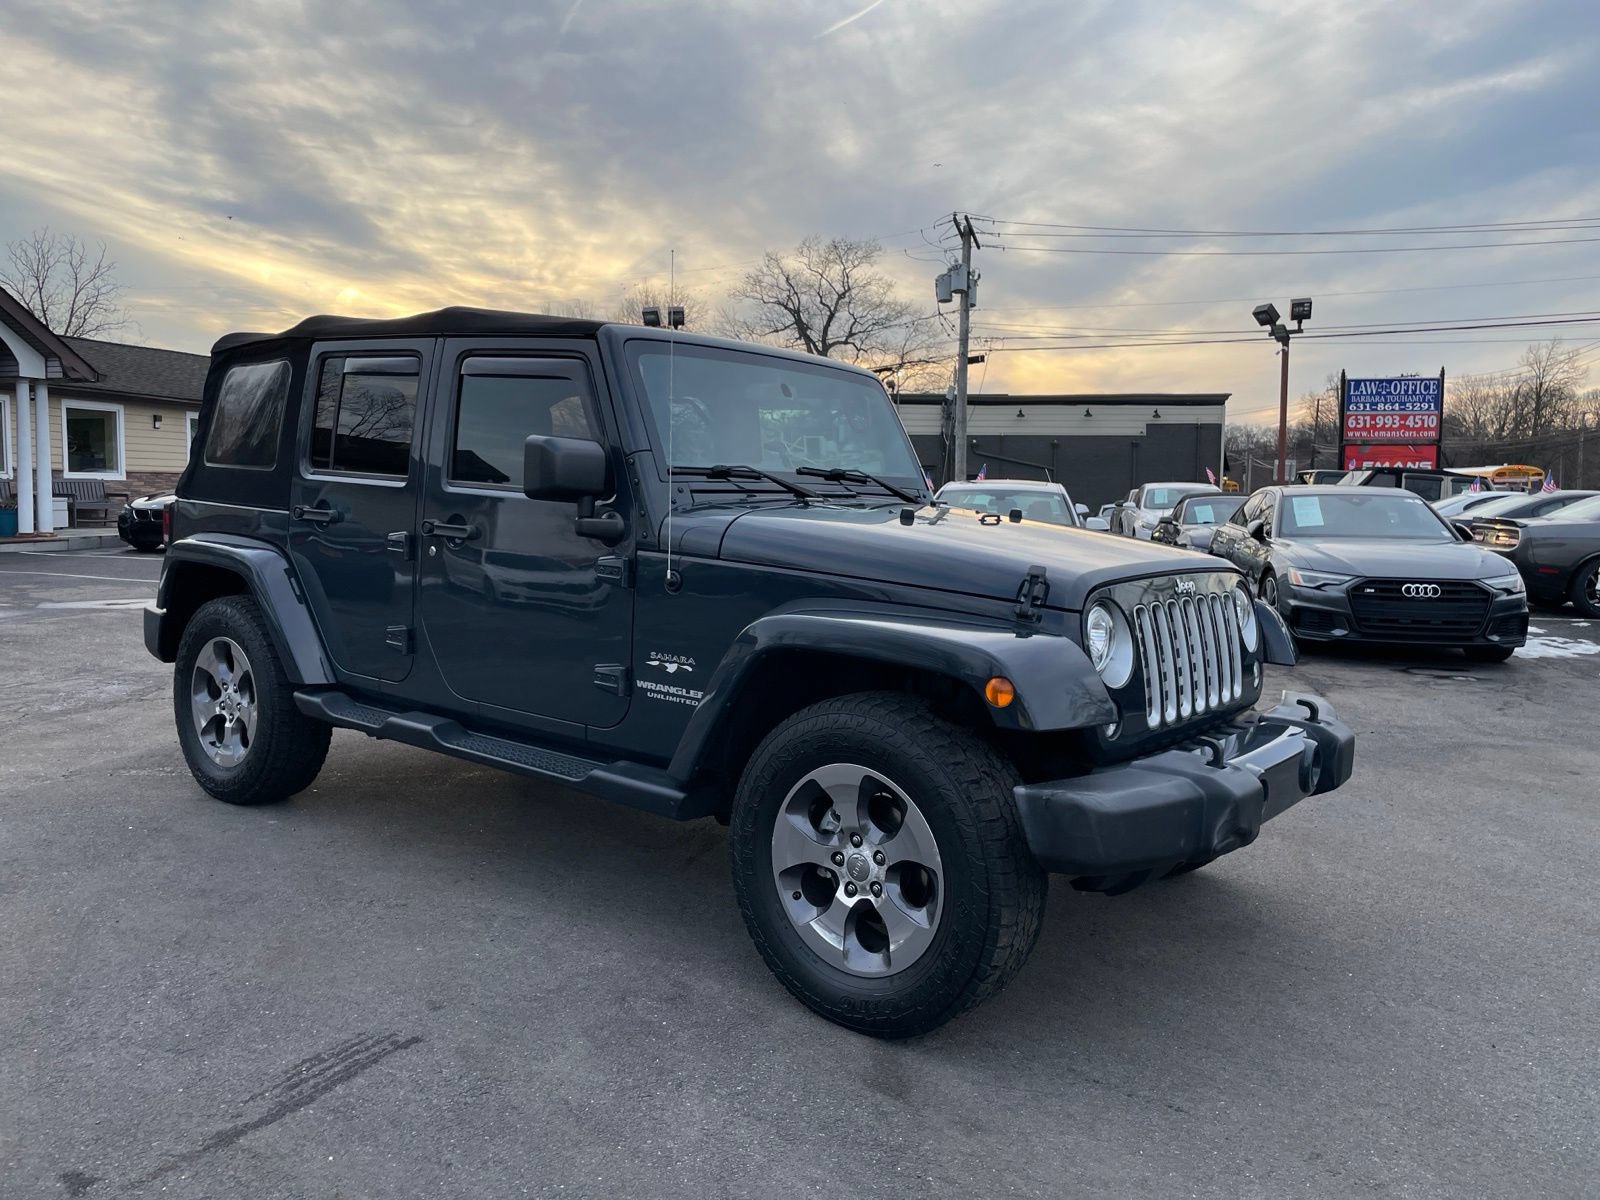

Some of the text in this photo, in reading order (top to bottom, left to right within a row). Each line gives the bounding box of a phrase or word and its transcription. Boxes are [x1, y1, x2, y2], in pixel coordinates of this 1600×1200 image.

[1350, 380, 1438, 395] LAW OFFICE
[1351, 395, 1385, 403] BARBARA
[1386, 395, 1425, 403] TOUHAMY
[1349, 402, 1436, 411] 631-864-5291
[1347, 415, 1438, 428] 631-993-4510
[1347, 429, 1436, 438] www.LemansCars.com
[1174, 578, 1196, 597] Jeep
[650, 651, 696, 665] SAHARA
[647, 691, 699, 706] UNLIMITED
